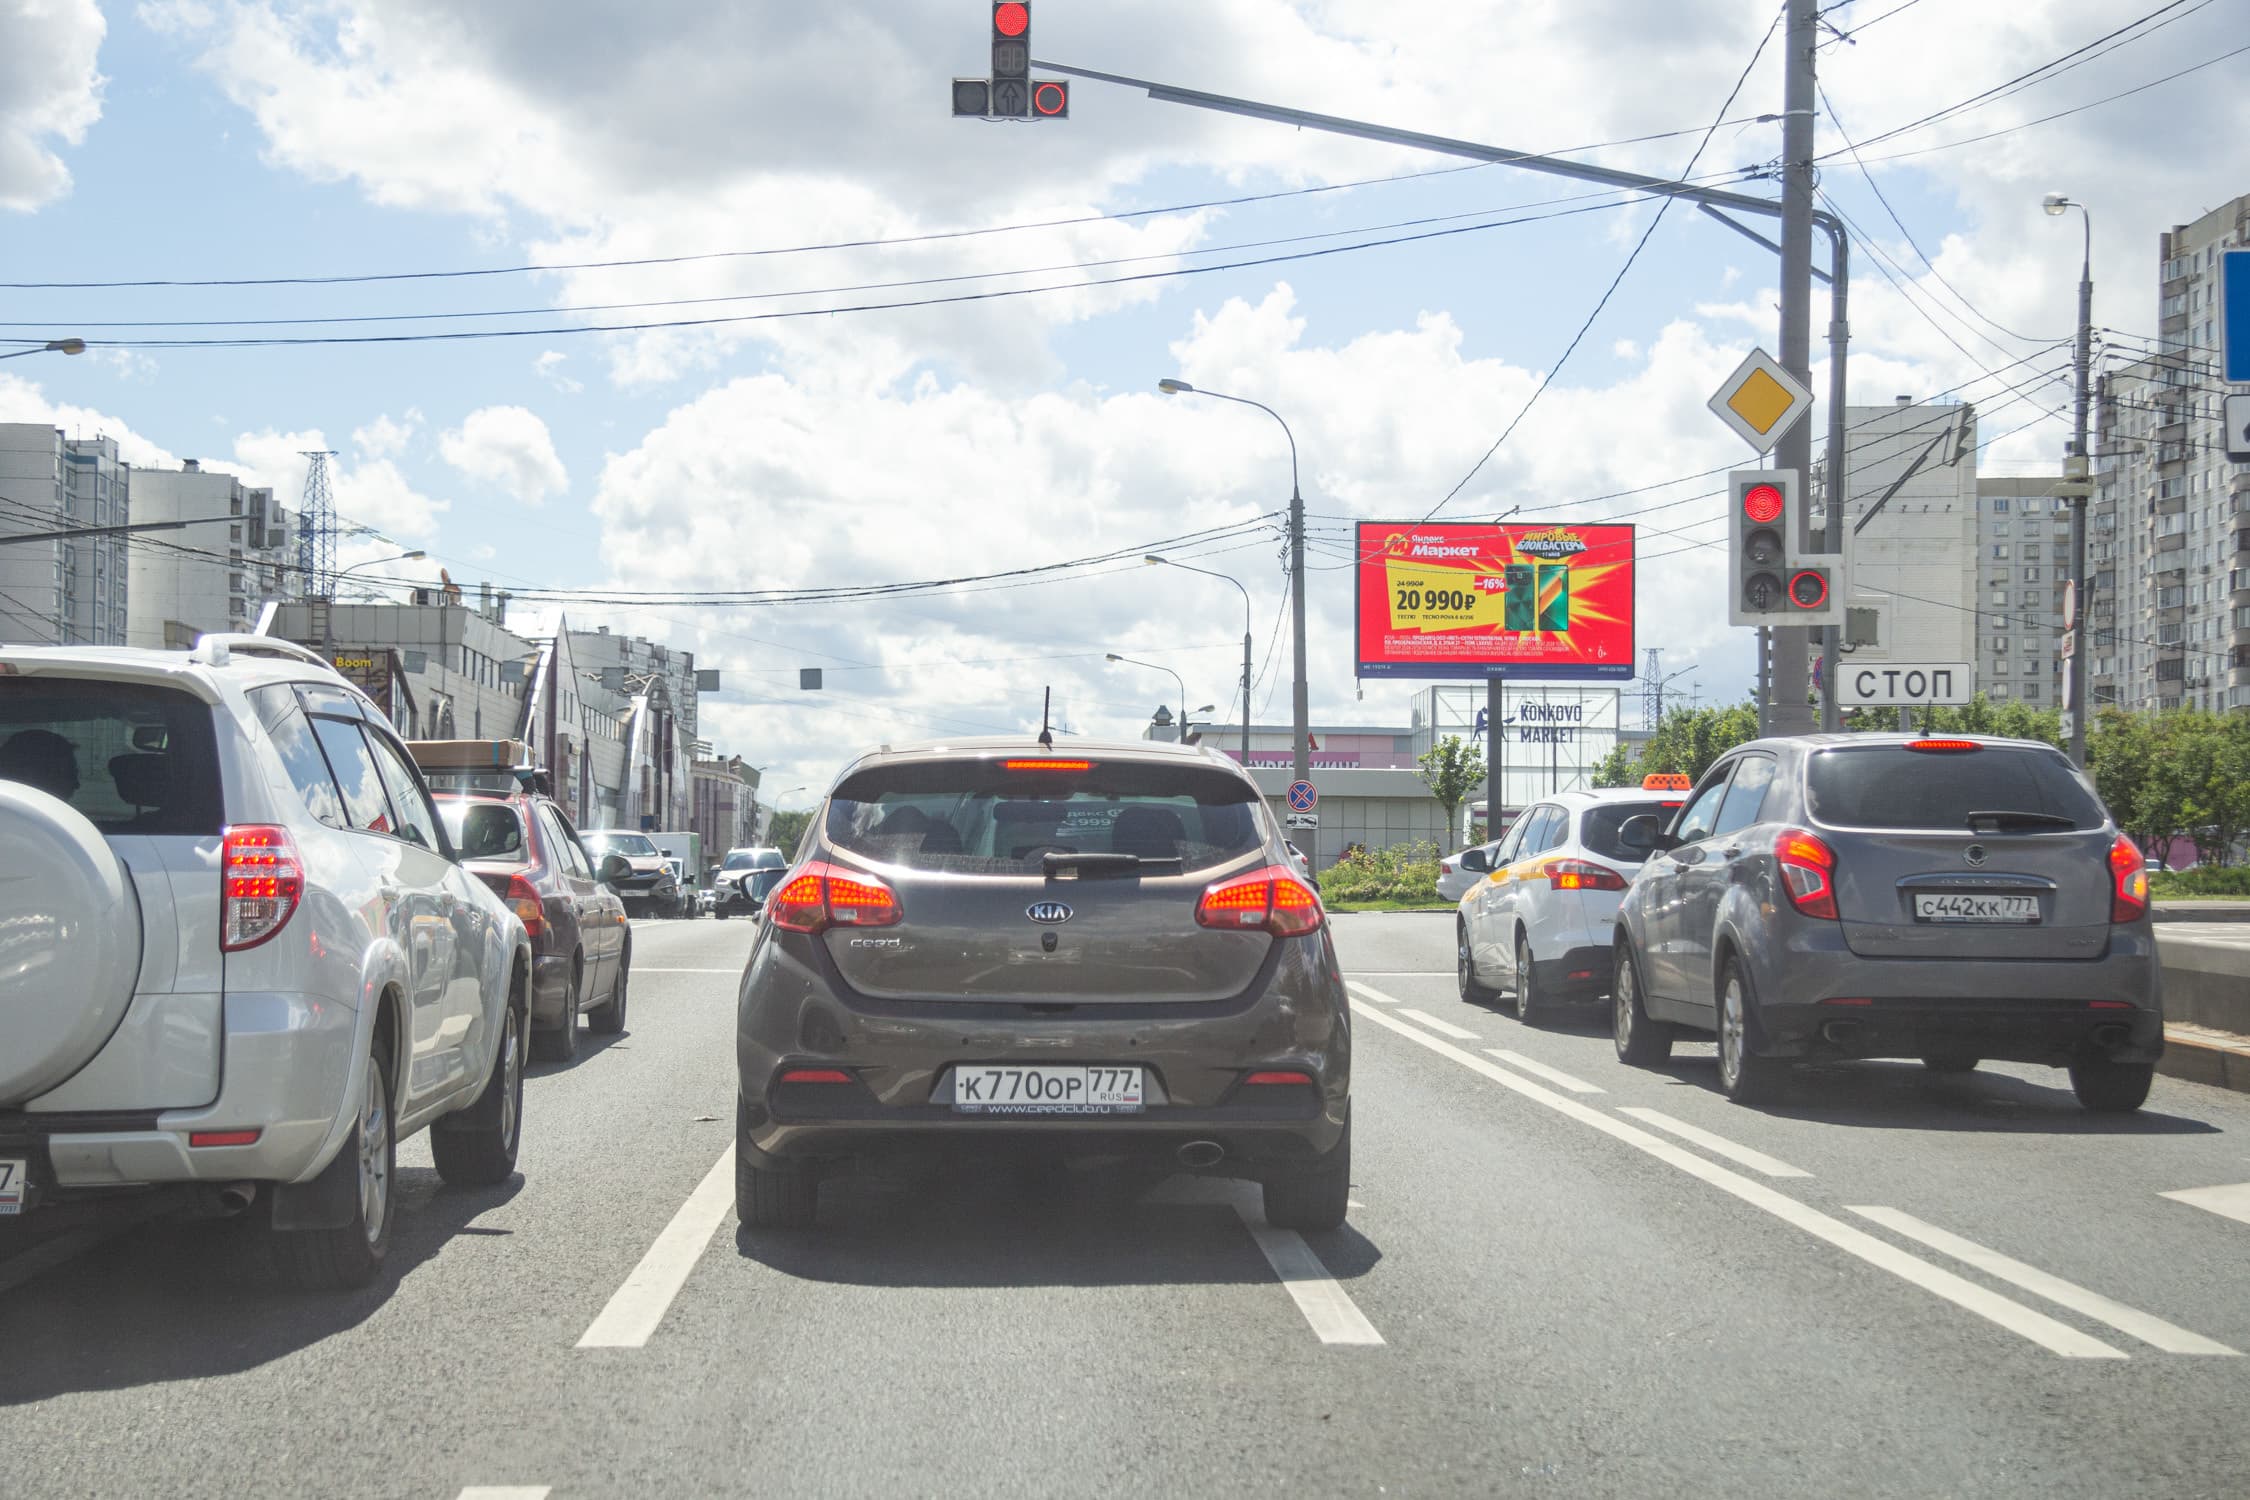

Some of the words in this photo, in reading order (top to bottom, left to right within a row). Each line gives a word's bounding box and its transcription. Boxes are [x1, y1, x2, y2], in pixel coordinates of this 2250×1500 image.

[1411, 535, 1445, 544] Яндекс
[1411, 545, 1479, 557] Маркет
[1397, 590, 1420, 610] 20
[335, 657, 372, 667] Boom
[1856, 670, 1952, 698] СТОП
[1520, 705, 1582, 722] KONKOVO
[1520, 727, 1575, 743] MARKET
[1035, 905, 1066, 919] KIA
[1923, 897, 2000, 916] С442КК
[2003, 897, 2032, 911] 777
[965, 1071, 1082, 1100] К770ОР
[1089, 1070, 1134, 1092] 777
[1100, 1093, 1122, 1101] RUS
[988, 1104, 1110, 1114] www.ceedclub.ru
